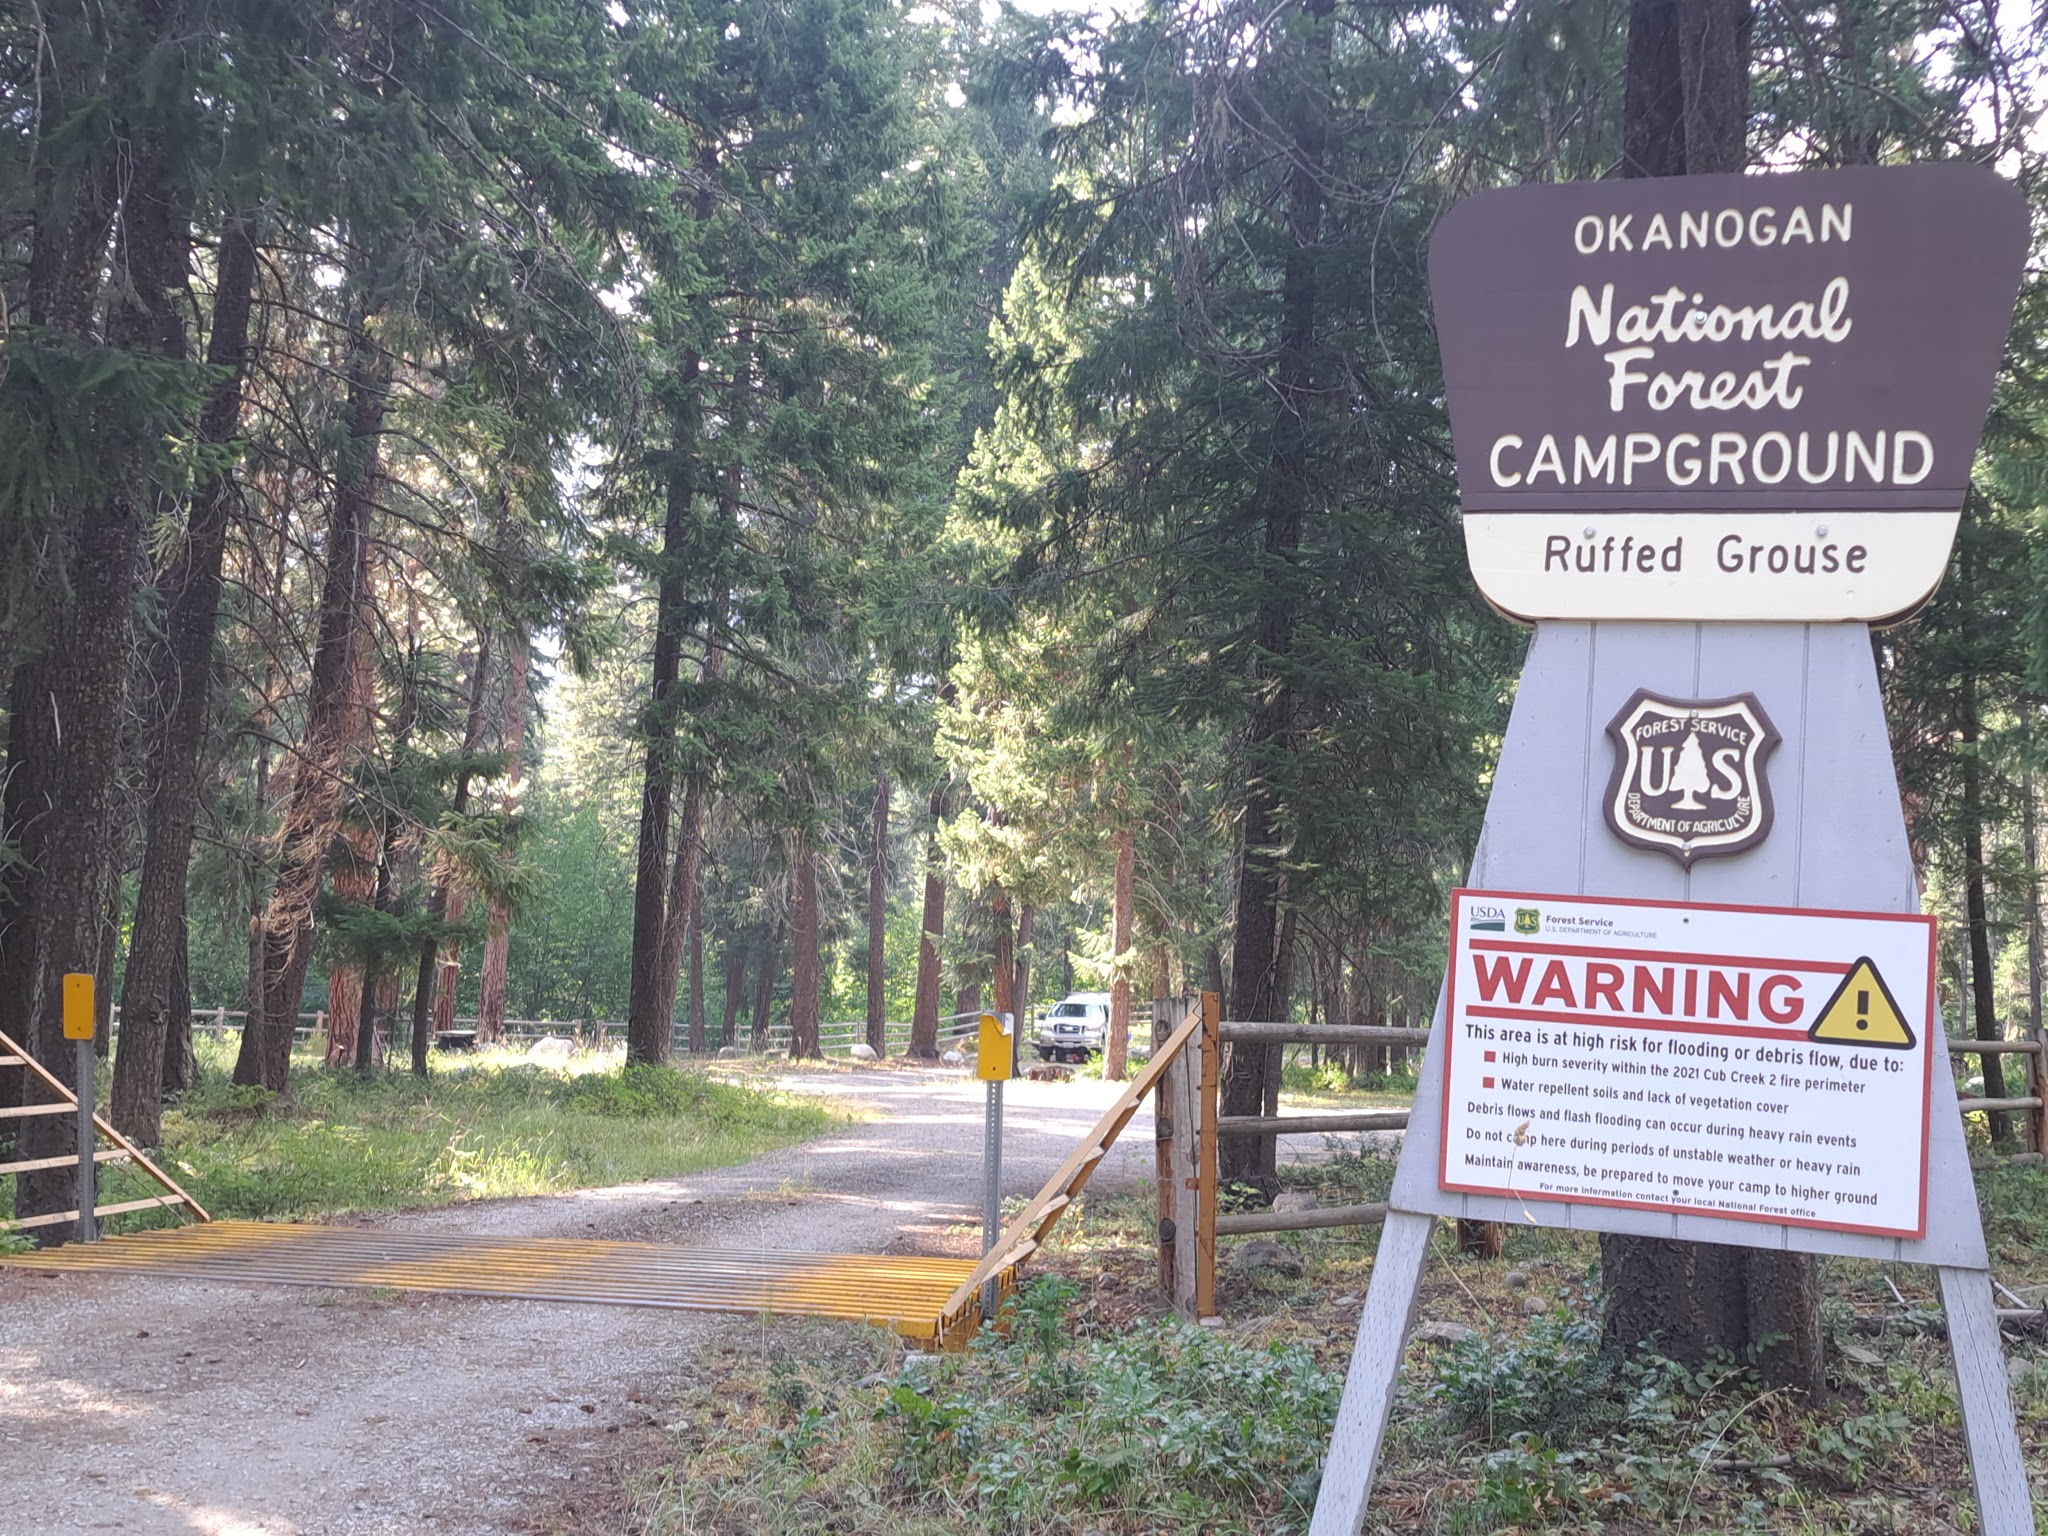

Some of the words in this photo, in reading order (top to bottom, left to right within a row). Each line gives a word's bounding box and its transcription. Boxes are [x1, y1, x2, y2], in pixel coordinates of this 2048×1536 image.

[1574, 203, 1852, 254] OKANOGAN
[1565, 276, 1853, 348] National
[1603, 346, 1810, 411] Forest
[1489, 430, 1934, 487] CAMPGROUND
[1544, 535, 1682, 573] Ruffed
[1717, 535, 1868, 575] Grouse
[1636, 718, 1687, 741] FOREST
[1690, 718, 1747, 746] SERVICE
[1628, 792, 1675, 832] DEPARTMENT
[1677, 820, 1693, 833] OF
[1692, 795, 1751, 833] AGRICULTURE
[1470, 906, 1506, 919] USDA
[1546, 915, 1576, 925] Forest
[1578, 917, 1614, 927] Service
[1558, 926, 1601, 935] DEPARTMENT
[1612, 930, 1656, 939] AGRICULTURE
[1472, 954, 1805, 1025] WARNING
[1465, 1023, 1495, 1041] This
[1500, 1029, 1532, 1043] area
[1537, 1028, 1549, 1045] is
[1553, 1031, 1568, 1046] at
[1573, 1031, 1604, 1052] high
[1610, 1034, 1637, 1052] risk
[1642, 1036, 1663, 1054] for
[1668, 1038, 1729, 1063] flooding
[1734, 1048, 1750, 1061] or
[1755, 1046, 1804, 1065] debris
[1808, 1049, 1844, 1071] flow,
[1849, 1053, 1878, 1071] due
[1884, 1056, 1904, 1073] to:
[1502, 1051, 1528, 1068] High
[1532, 1054, 1558, 1068] burn
[1562, 1058, 1608, 1075] severity
[1611, 1061, 1646, 1075] within
[1650, 1064, 1669, 1077] the
[1673, 1066, 1699, 1080] 2021
[1703, 1068, 1726, 1082] Cub
[1730, 1070, 1765, 1086] Creek
[1769, 1073, 1776, 1086] 2
[1780, 1074, 1801, 1088] fire
[1805, 1077, 1866, 1094] perimeter
[1501, 1078, 1535, 1092] Water
[1538, 1083, 1589, 1097] repellent
[1592, 1086, 1619, 1100] soils
[1622, 1089, 1644, 1102] and
[1648, 1090, 1671, 1104] lack
[1675, 1092, 1686, 1105] of
[1689, 1096, 1752, 1111] vegetation
[1756, 1102, 1789, 1114] cover
[1467, 1101, 1504, 1116] Debris
[1507, 1104, 1536, 1119] flows
[1539, 1108, 1560, 1121] and
[1564, 1109, 1591, 1124] flash
[1595, 1112, 1642, 1131] flooding
[1645, 1119, 1666, 1131] can
[1670, 1121, 1702, 1134] occur
[1706, 1122, 1744, 1141] during
[1749, 1126, 1785, 1144] heavy
[1788, 1130, 1812, 1144] rain
[1816, 1135, 1857, 1148] events
[1466, 1127, 1481, 1140] Do
[1484, 1130, 1503, 1142] not
[1506, 1133, 1537, 1147] cp
[1541, 1134, 1566, 1148] here
[1570, 1136, 1607, 1155] during
[1611, 1141, 1654, 1156] periods
[1658, 1145, 1669, 1158] of
[1673, 1148, 1724, 1163] unstable
[1727, 1153, 1776, 1168] weather
[1779, 1158, 1792, 1169] or
[1796, 1158, 1832, 1176] heavy
[1836, 1162, 1860, 1176] rain
[1465, 1153, 1514, 1169] Maintain
[1517, 1160, 1580, 1178] awareness,
[1583, 1164, 1597, 1178] be
[1601, 1168, 1653, 1183] prepared
[1657, 1171, 1668, 1185] to
[1672, 1175, 1704, 1188] move
[1708, 1179, 1734, 1192] your
[1738, 1182, 1771, 1198] camp
[1775, 1183, 1787, 1196] to
[1791, 1184, 1830, 1202] higher
[1834, 1192, 1878, 1206] ground
[1540, 1182, 1554, 1191] For
[1556, 1185, 1579, 1194] more
[1582, 1186, 1632, 1197] information
[1636, 1192, 1669, 1203] contact
[1671, 1194, 1692, 1205] your
[1694, 1197, 1715, 1208] local
[1718, 1200, 1756, 1212] National
[1759, 1204, 1788, 1215] Forest
[1790, 1207, 1816, 1218] office
